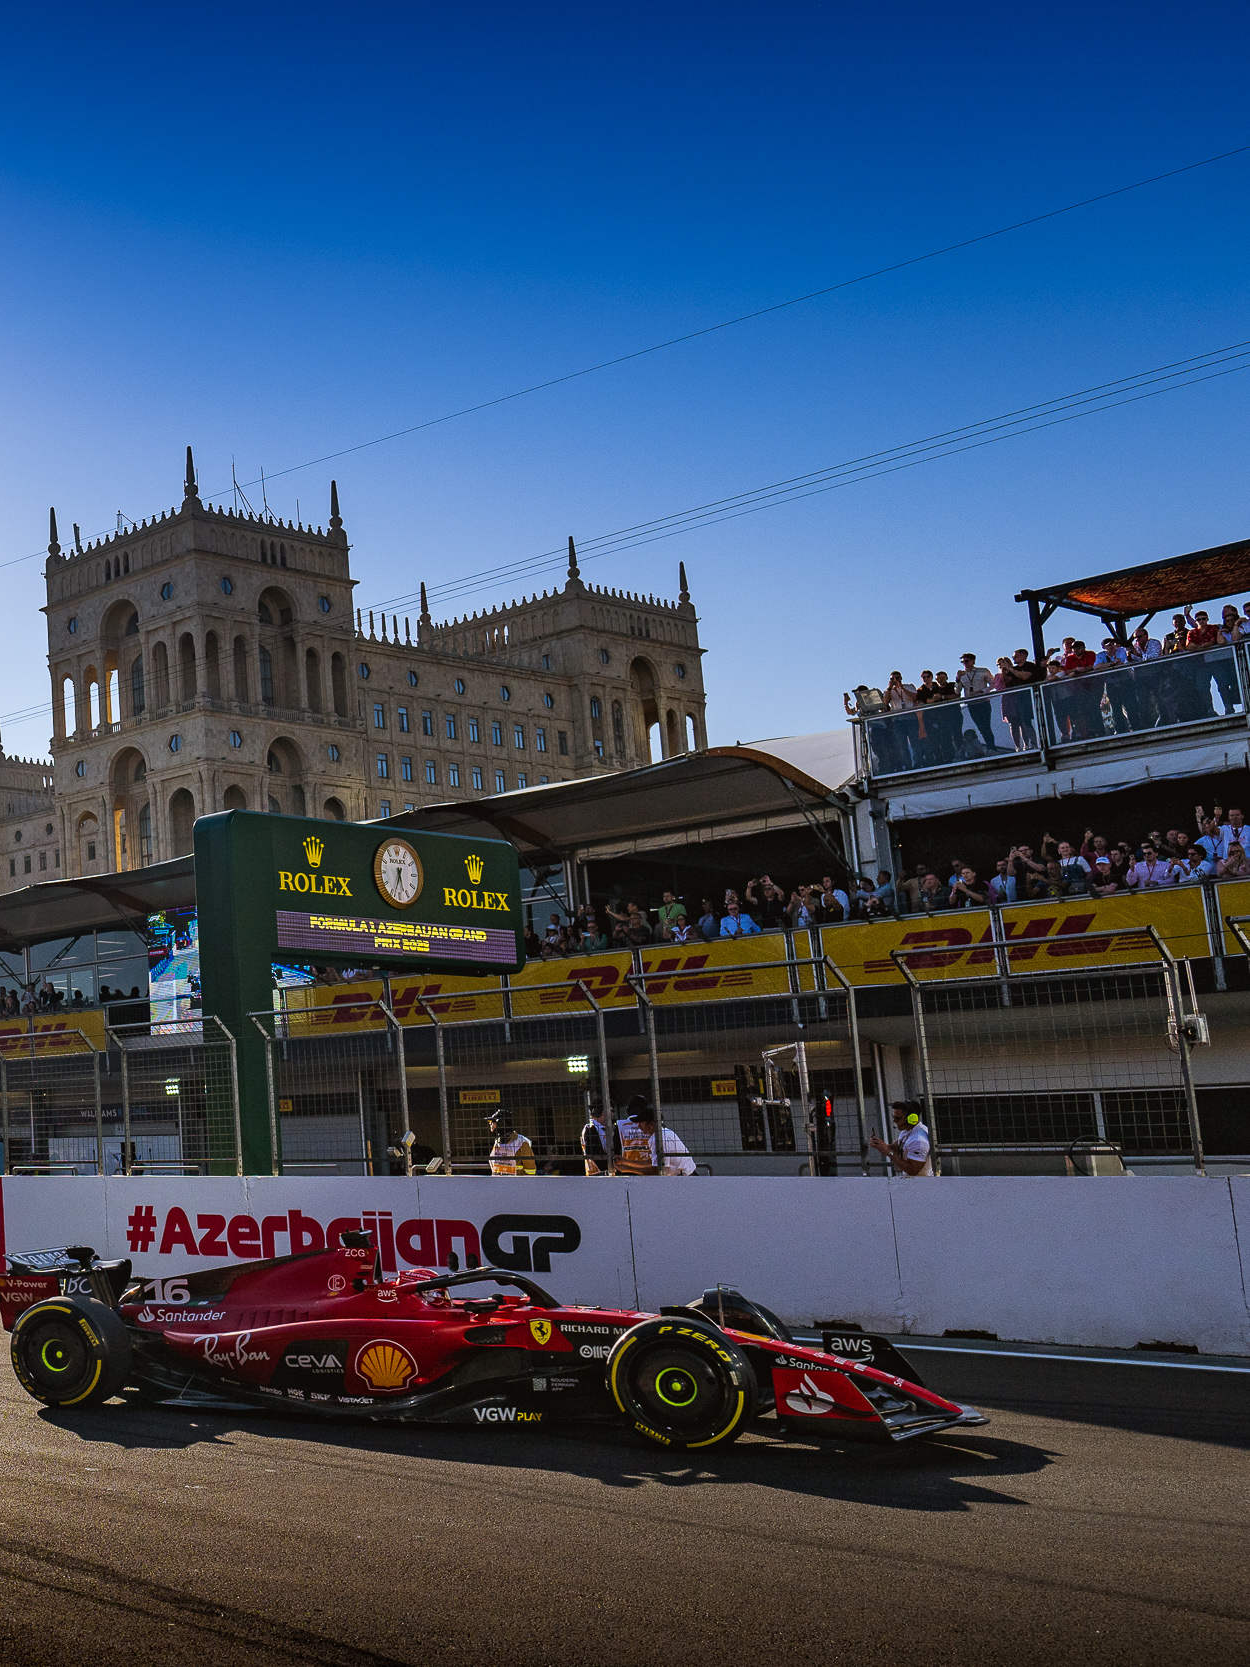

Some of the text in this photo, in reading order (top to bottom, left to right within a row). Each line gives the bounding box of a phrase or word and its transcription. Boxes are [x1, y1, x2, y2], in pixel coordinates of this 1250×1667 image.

[389, 857, 406, 865] ROLEX
[278, 870, 352, 897] ROLEX
[443, 887, 510, 911] ROLEX
[310, 916, 369, 933] FORMULA
[378, 922, 448, 939] AZERBAIJAN
[449, 928, 487, 942] GRAND
[374, 936, 401, 949] PRIX
[896, 913, 1116, 970] DHL
[557, 954, 722, 1003] DHL
[331, 984, 453, 1024] DHL
[80, 1107, 147, 1118] WILLAMS RCING
[344, 1248, 366, 1258] ZCG
[6, 1279, 48, 1289] V-Power
[0, 1291, 34, 1303] VGW
[143, 1278, 191, 1305] 16
[156, 1308, 227, 1322] Santander
[560, 1324, 610, 1334] RICHARD
[675, 1327, 732, 1362] ZERO
[831, 1337, 873, 1353] aws
[259, 1385, 283, 1396] brembo
[287, 1388, 304, 1398] NGK
[472, 1407, 543, 1422] VGW PLAY
